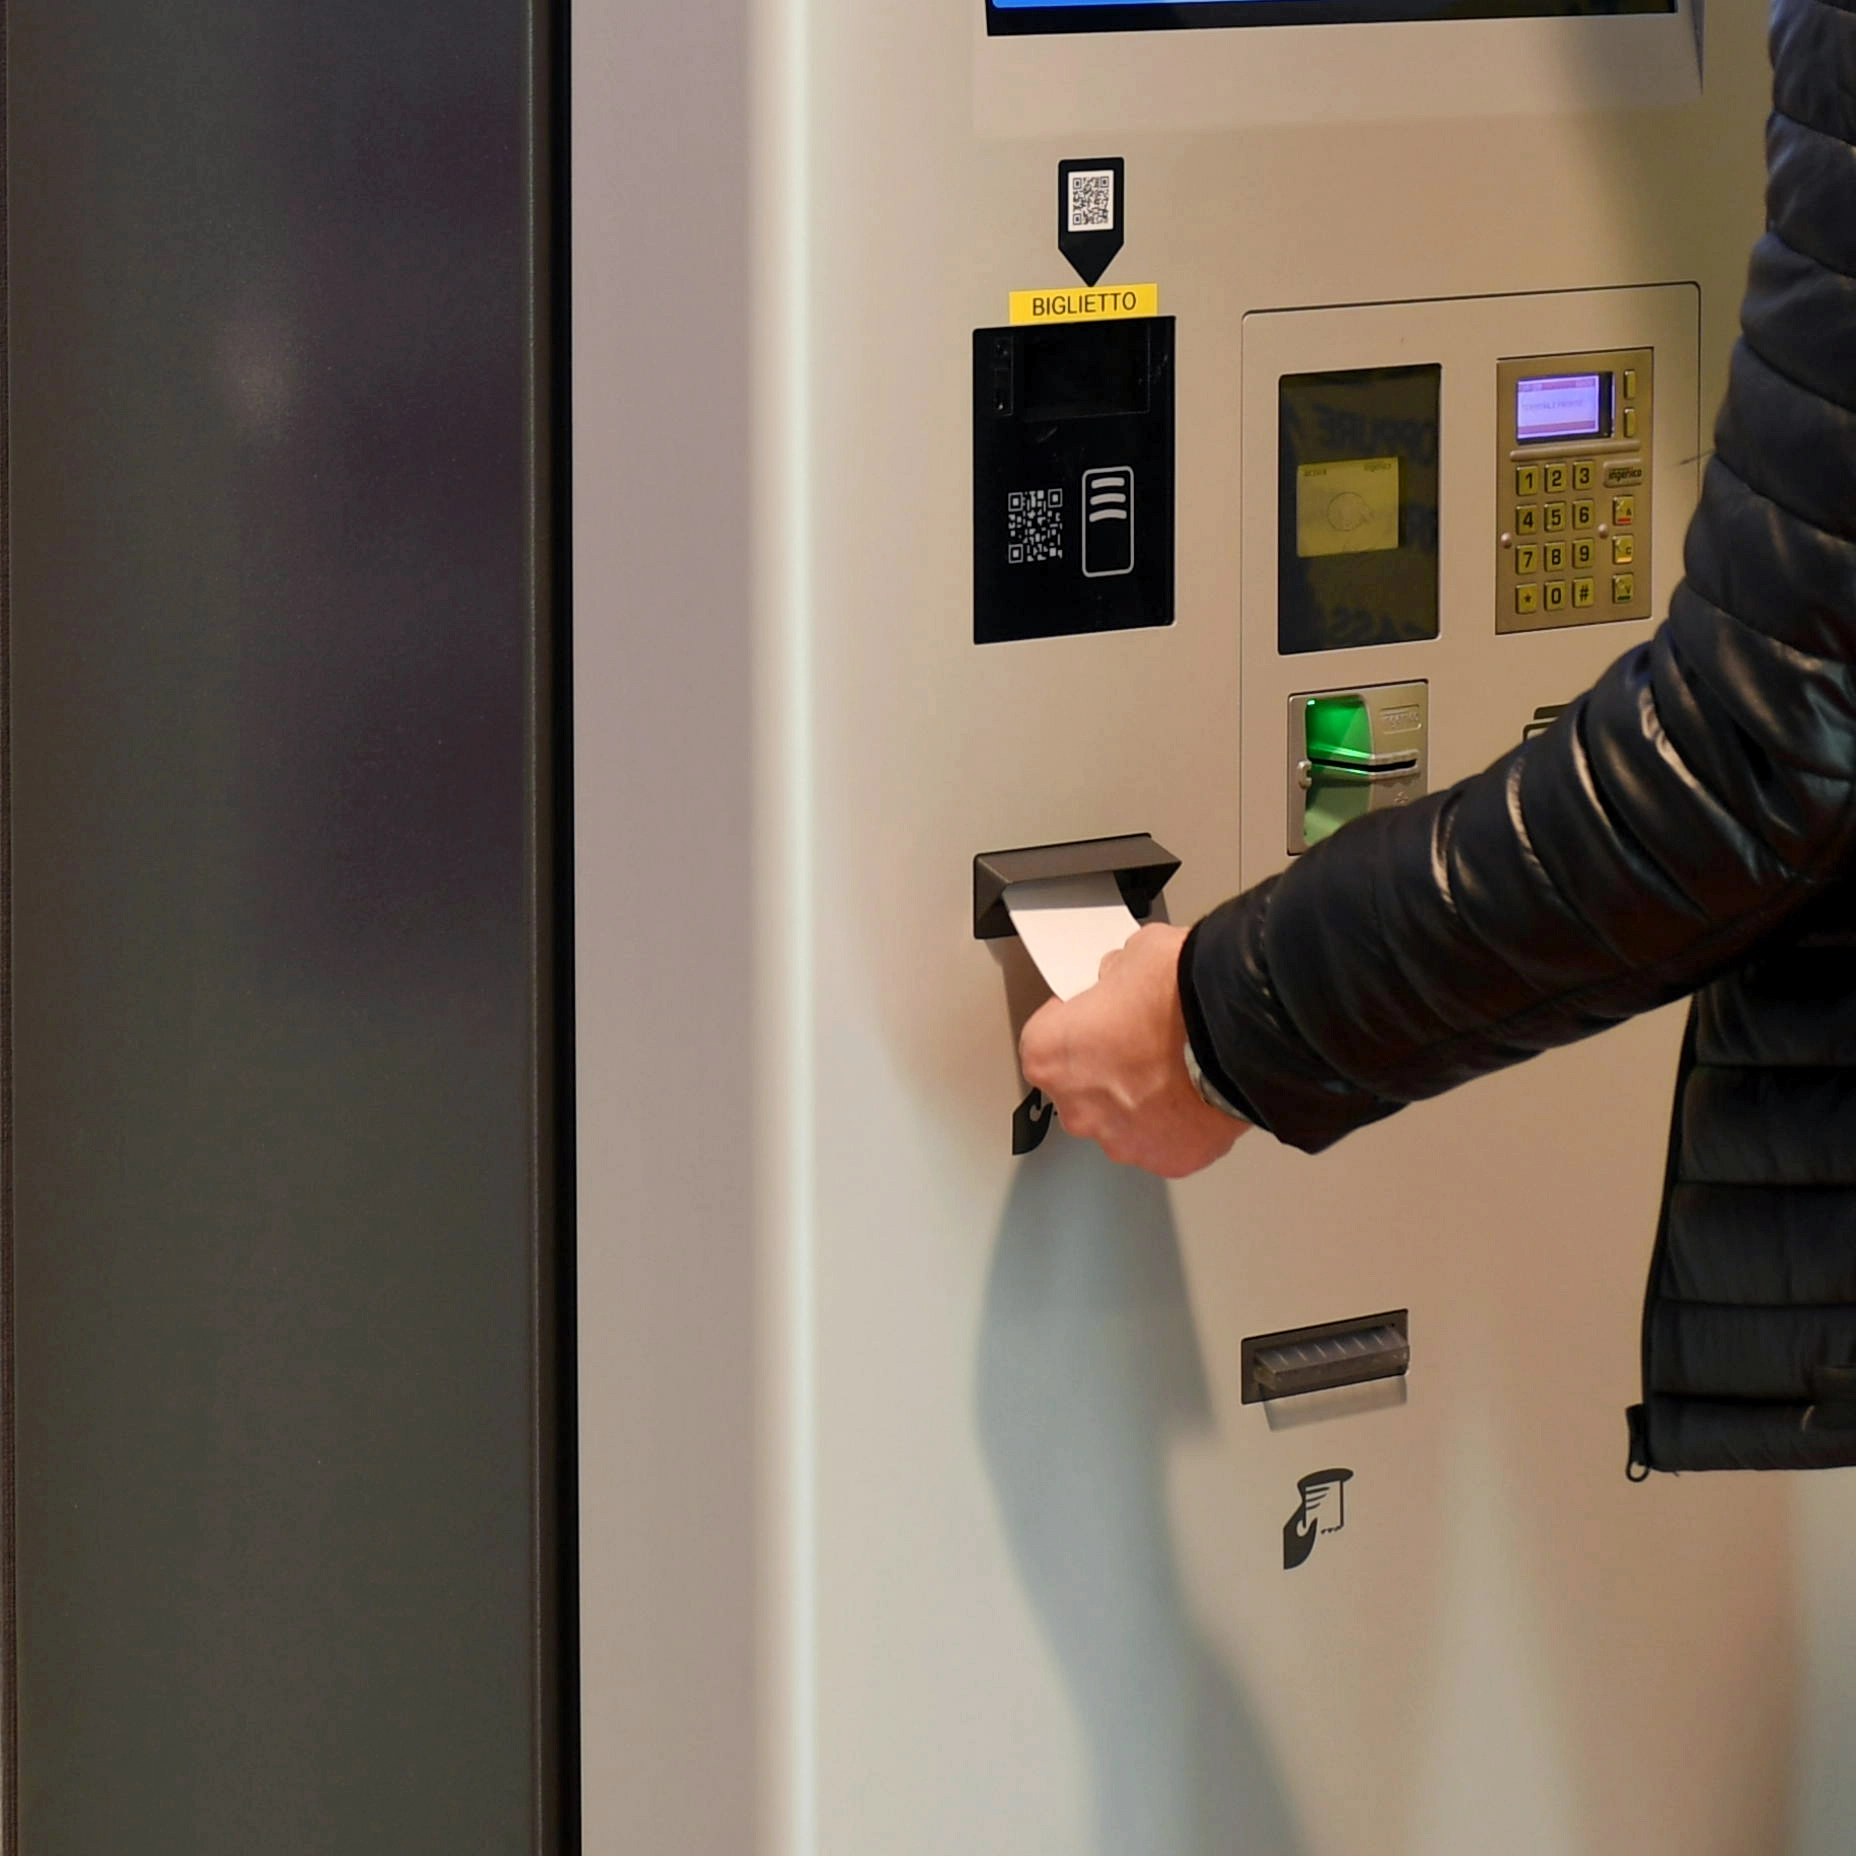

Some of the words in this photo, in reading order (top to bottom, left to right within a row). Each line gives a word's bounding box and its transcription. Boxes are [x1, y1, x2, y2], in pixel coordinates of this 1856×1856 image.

[1032, 292, 1137, 316] BIGLIETTO
[1525, 473, 1533, 489] 1
[1552, 470, 1562, 486] 2
[1580, 467, 1590, 484] 3
[1523, 512, 1534, 528] 4
[1551, 509, 1561, 526] 5
[1579, 506, 1590, 523] 6
[1523, 551, 1533, 568] 7
[1551, 549, 1561, 565] 8
[1579, 545, 1590, 562] 9
